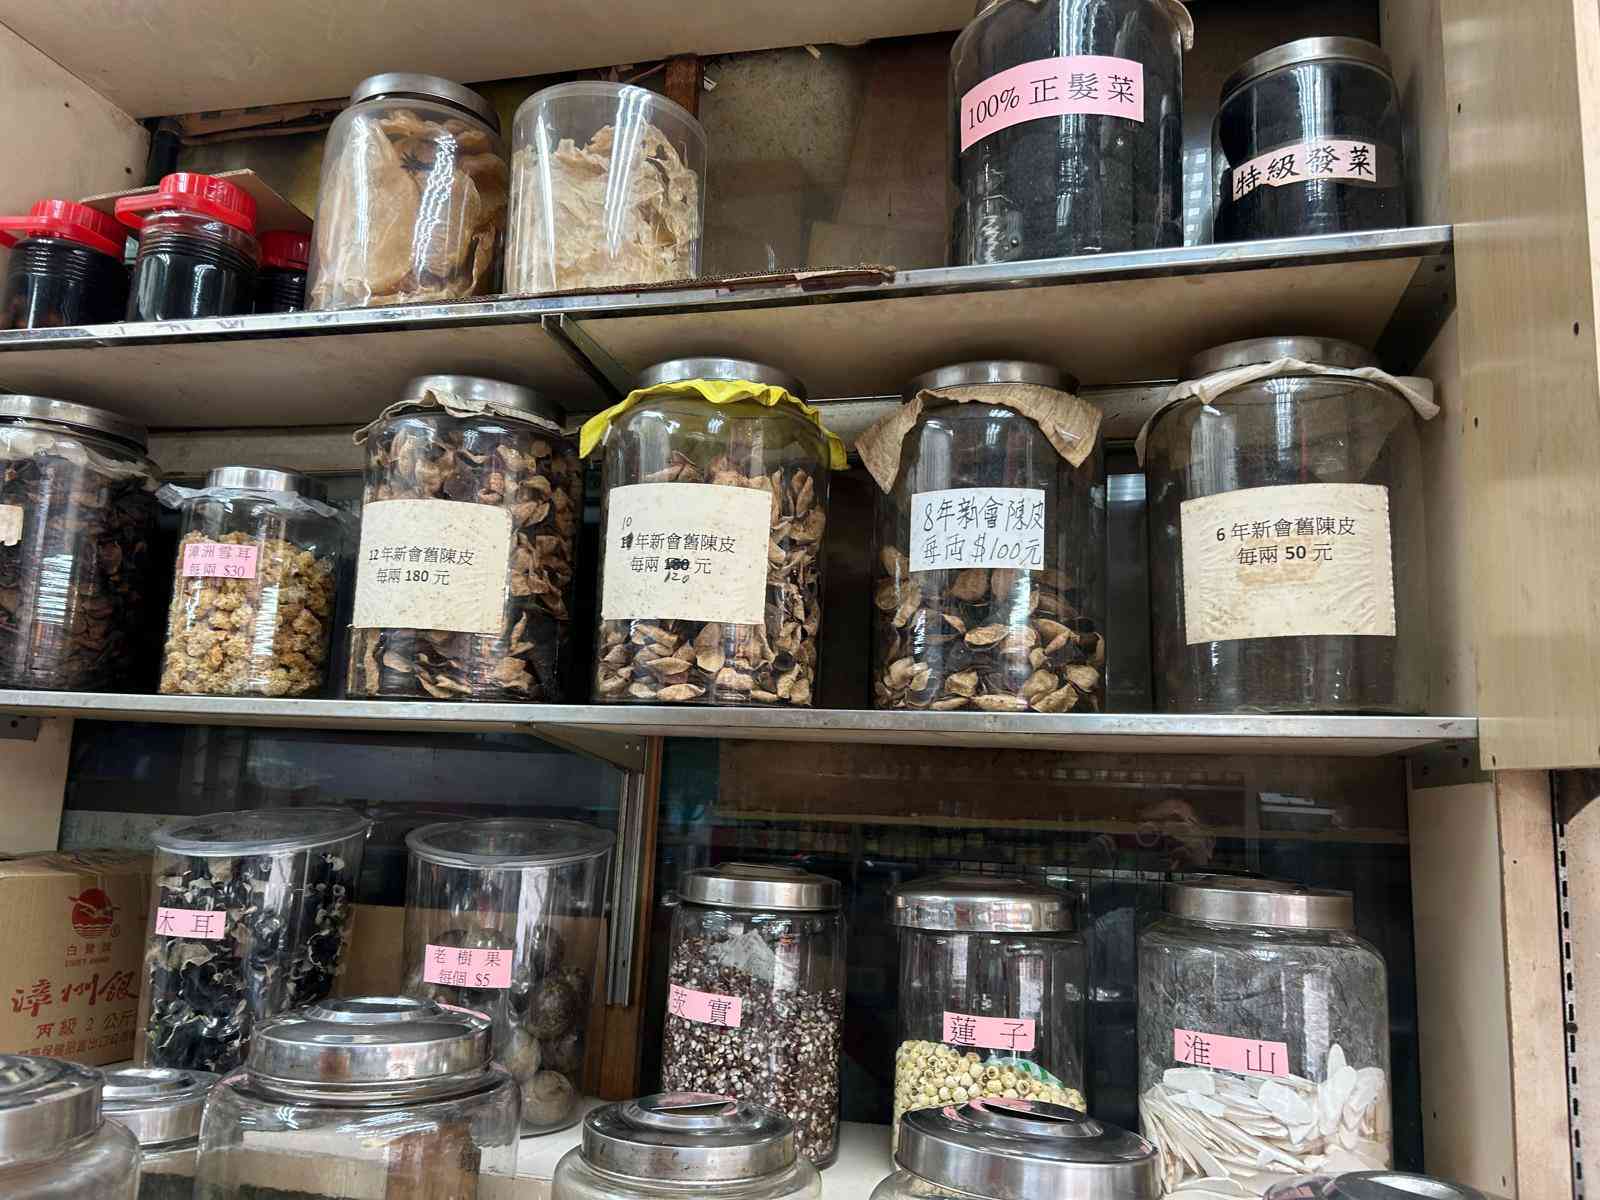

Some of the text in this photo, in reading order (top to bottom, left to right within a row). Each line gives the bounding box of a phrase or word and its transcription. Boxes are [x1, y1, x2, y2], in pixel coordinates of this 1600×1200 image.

[968, 72, 1135, 130] 100% 正髮菜
[1235, 145, 1374, 196] 特級發菜
[950, 1016, 1028, 1049] 蓮子
[1184, 1033, 1276, 1074] 淮山
